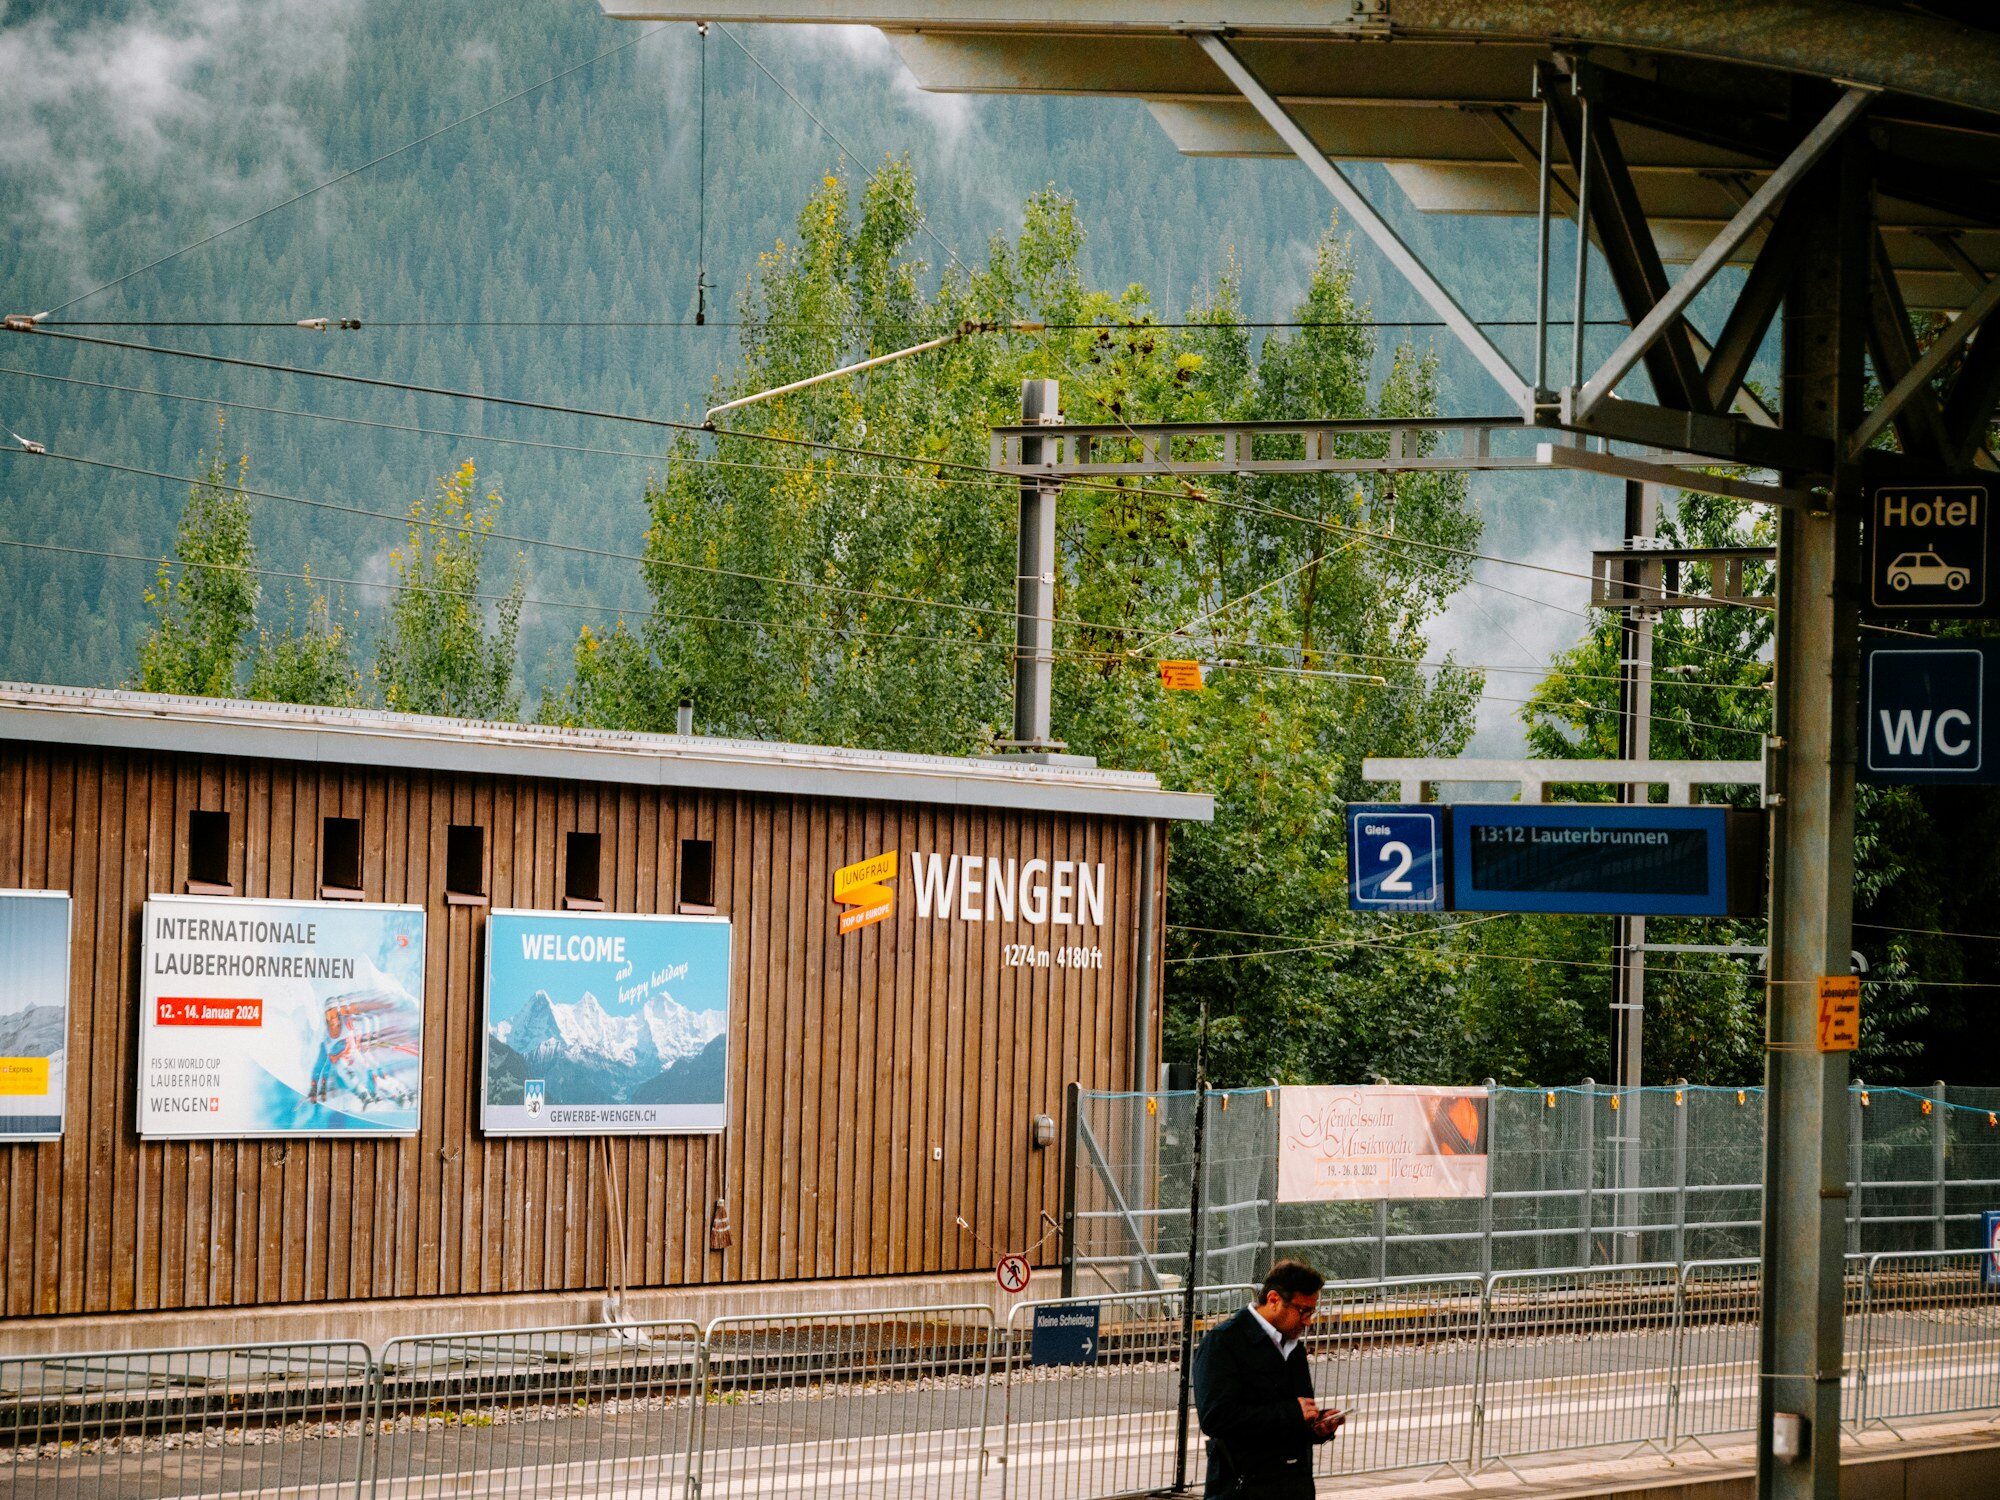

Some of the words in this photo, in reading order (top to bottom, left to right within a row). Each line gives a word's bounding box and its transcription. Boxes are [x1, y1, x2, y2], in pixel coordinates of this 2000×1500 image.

[1884, 496, 1977, 526] Hotel
[1879, 709, 1971, 756] WC
[1364, 824, 1392, 836] Gleis
[1478, 826, 1525, 842] 13:12
[1531, 827, 1669, 845] Lauterbrunnen
[1379, 840, 1413, 892] 2
[911, 851, 1105, 926] WENGEN
[156, 917, 317, 944] INTERNATIONALE
[521, 933, 626, 963] WELCOME
[154, 952, 355, 979] LAUBERHORNRENNEN
[615, 959, 633, 982] and
[618, 981, 649, 1006] happy
[651, 961, 689, 988] holidays
[159, 1003, 175, 1019] 12.
[184, 1003, 199, 1019] 14.
[201, 1004, 235, 1020] Januar
[236, 1005, 260, 1020] 2024
[151, 1058, 162, 1069] FIS
[164, 1058, 176, 1069] SKI
[178, 1058, 204, 1069] WORLD
[206, 1058, 221, 1069] CUP
[150, 1074, 220, 1087] LAUBERHORN
[150, 1097, 209, 1112] WENGEN
[550, 1109, 657, 1123] GEWERBE-WENGEN.CH
[1293, 1096, 1395, 1142] Mendelssohn
[1322, 1128, 1413, 1158] Musikwoche
[1037, 1315, 1059, 1328] Kleine
[1059, 1314, 1095, 1328] Scheidegg
